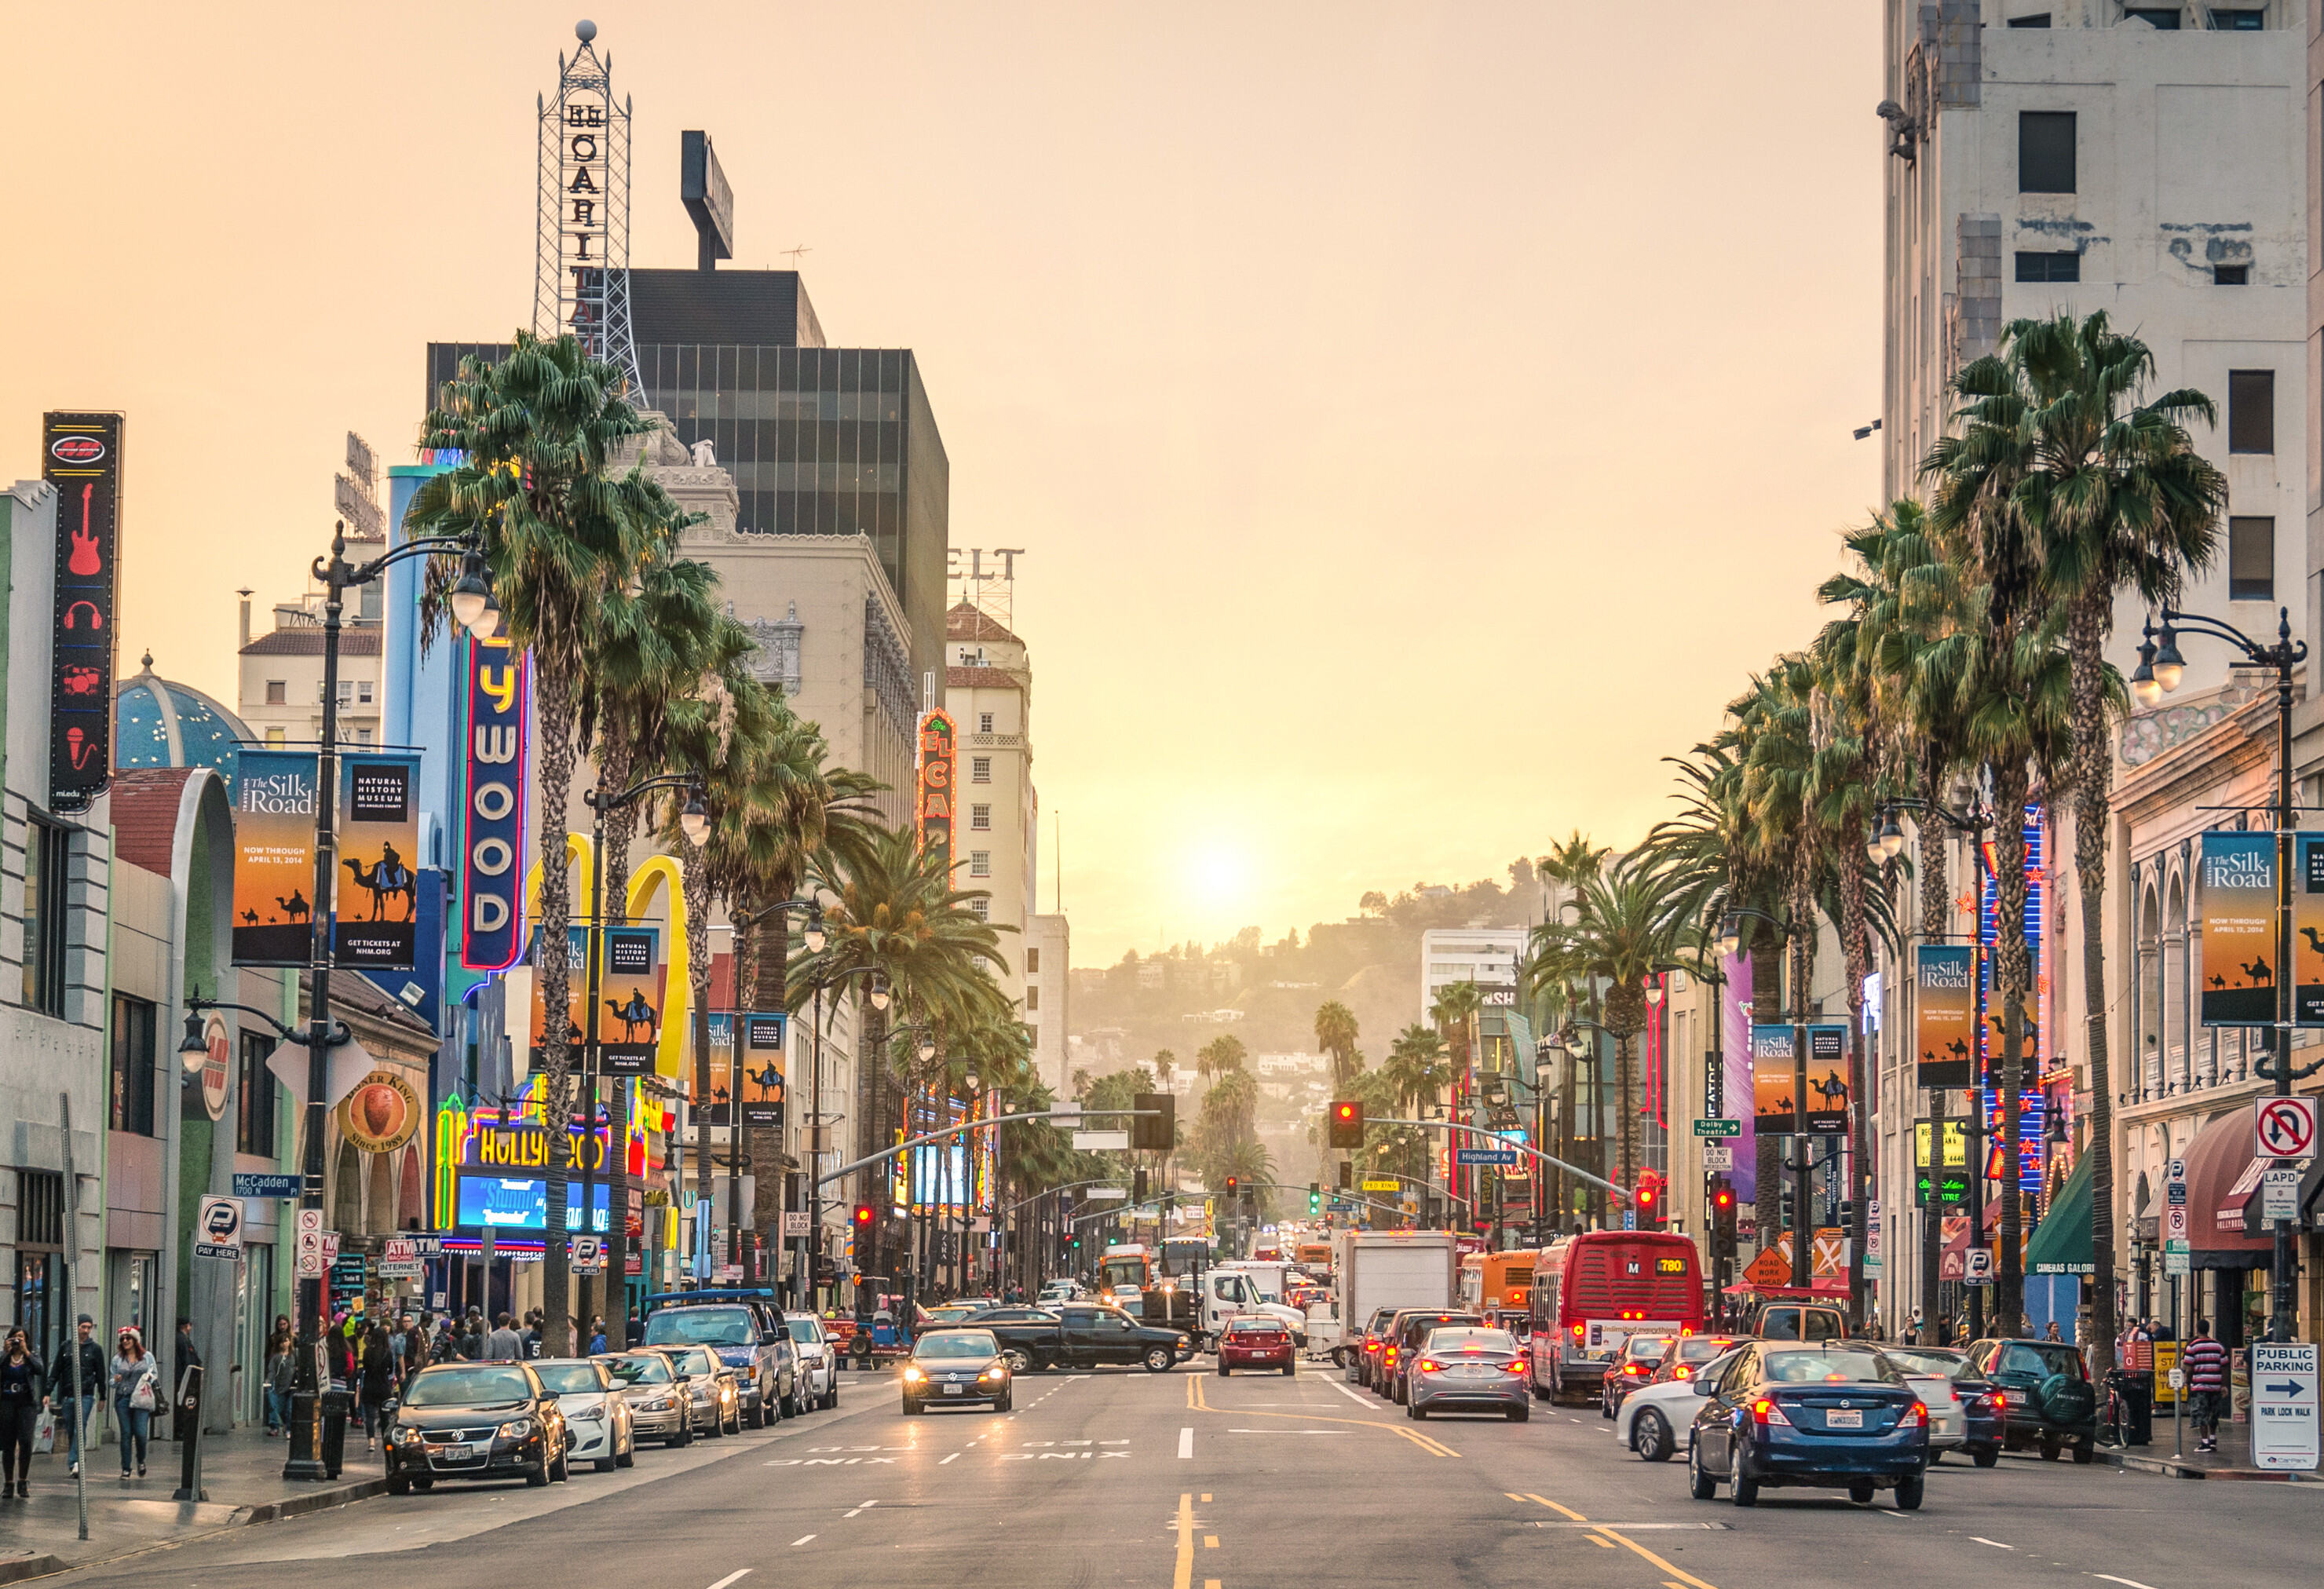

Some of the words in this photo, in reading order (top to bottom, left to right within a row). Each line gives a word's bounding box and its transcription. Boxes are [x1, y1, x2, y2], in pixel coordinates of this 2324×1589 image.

[924, 731, 952, 757] EL
[251, 778, 268, 788] The
[268, 775, 307, 796] Silk
[250, 789, 312, 814] Road
[2214, 856, 2229, 865] The
[2229, 853, 2265, 872] Silk
[2213, 867, 2271, 888] Road
[1938, 961, 1964, 976] Silk
[1928, 971, 1968, 988] Road
[709, 1032, 729, 1046] oad
[1769, 1036, 1789, 1049] Silk
[1760, 1045, 1792, 1058] Road
[389, 1076, 414, 1104] KING
[1701, 1120, 1722, 1129] Dolby
[349, 1132, 377, 1150] Since
[381, 1135, 403, 1150] 1989
[1463, 1153, 1497, 1162] Highland
[236, 1176, 288, 1187] McCadden
[2265, 1173, 2295, 1182] LAPD
[216, 1248, 236, 1258] HERE
[388, 1242, 414, 1254] ATM
[1628, 1263, 1639, 1273] M
[1661, 1259, 1682, 1271] 780
[2037, 1263, 2065, 1273] CAMERAS
[532, 1344, 540, 1357] 5
[2256, 1350, 2313, 1359] PUBLIC
[2256, 1362, 2314, 1372] PARKING
[2261, 1407, 2275, 1416] PARK
[2278, 1408, 2293, 1416] LOCK
[2295, 1408, 2310, 1416] WALK
